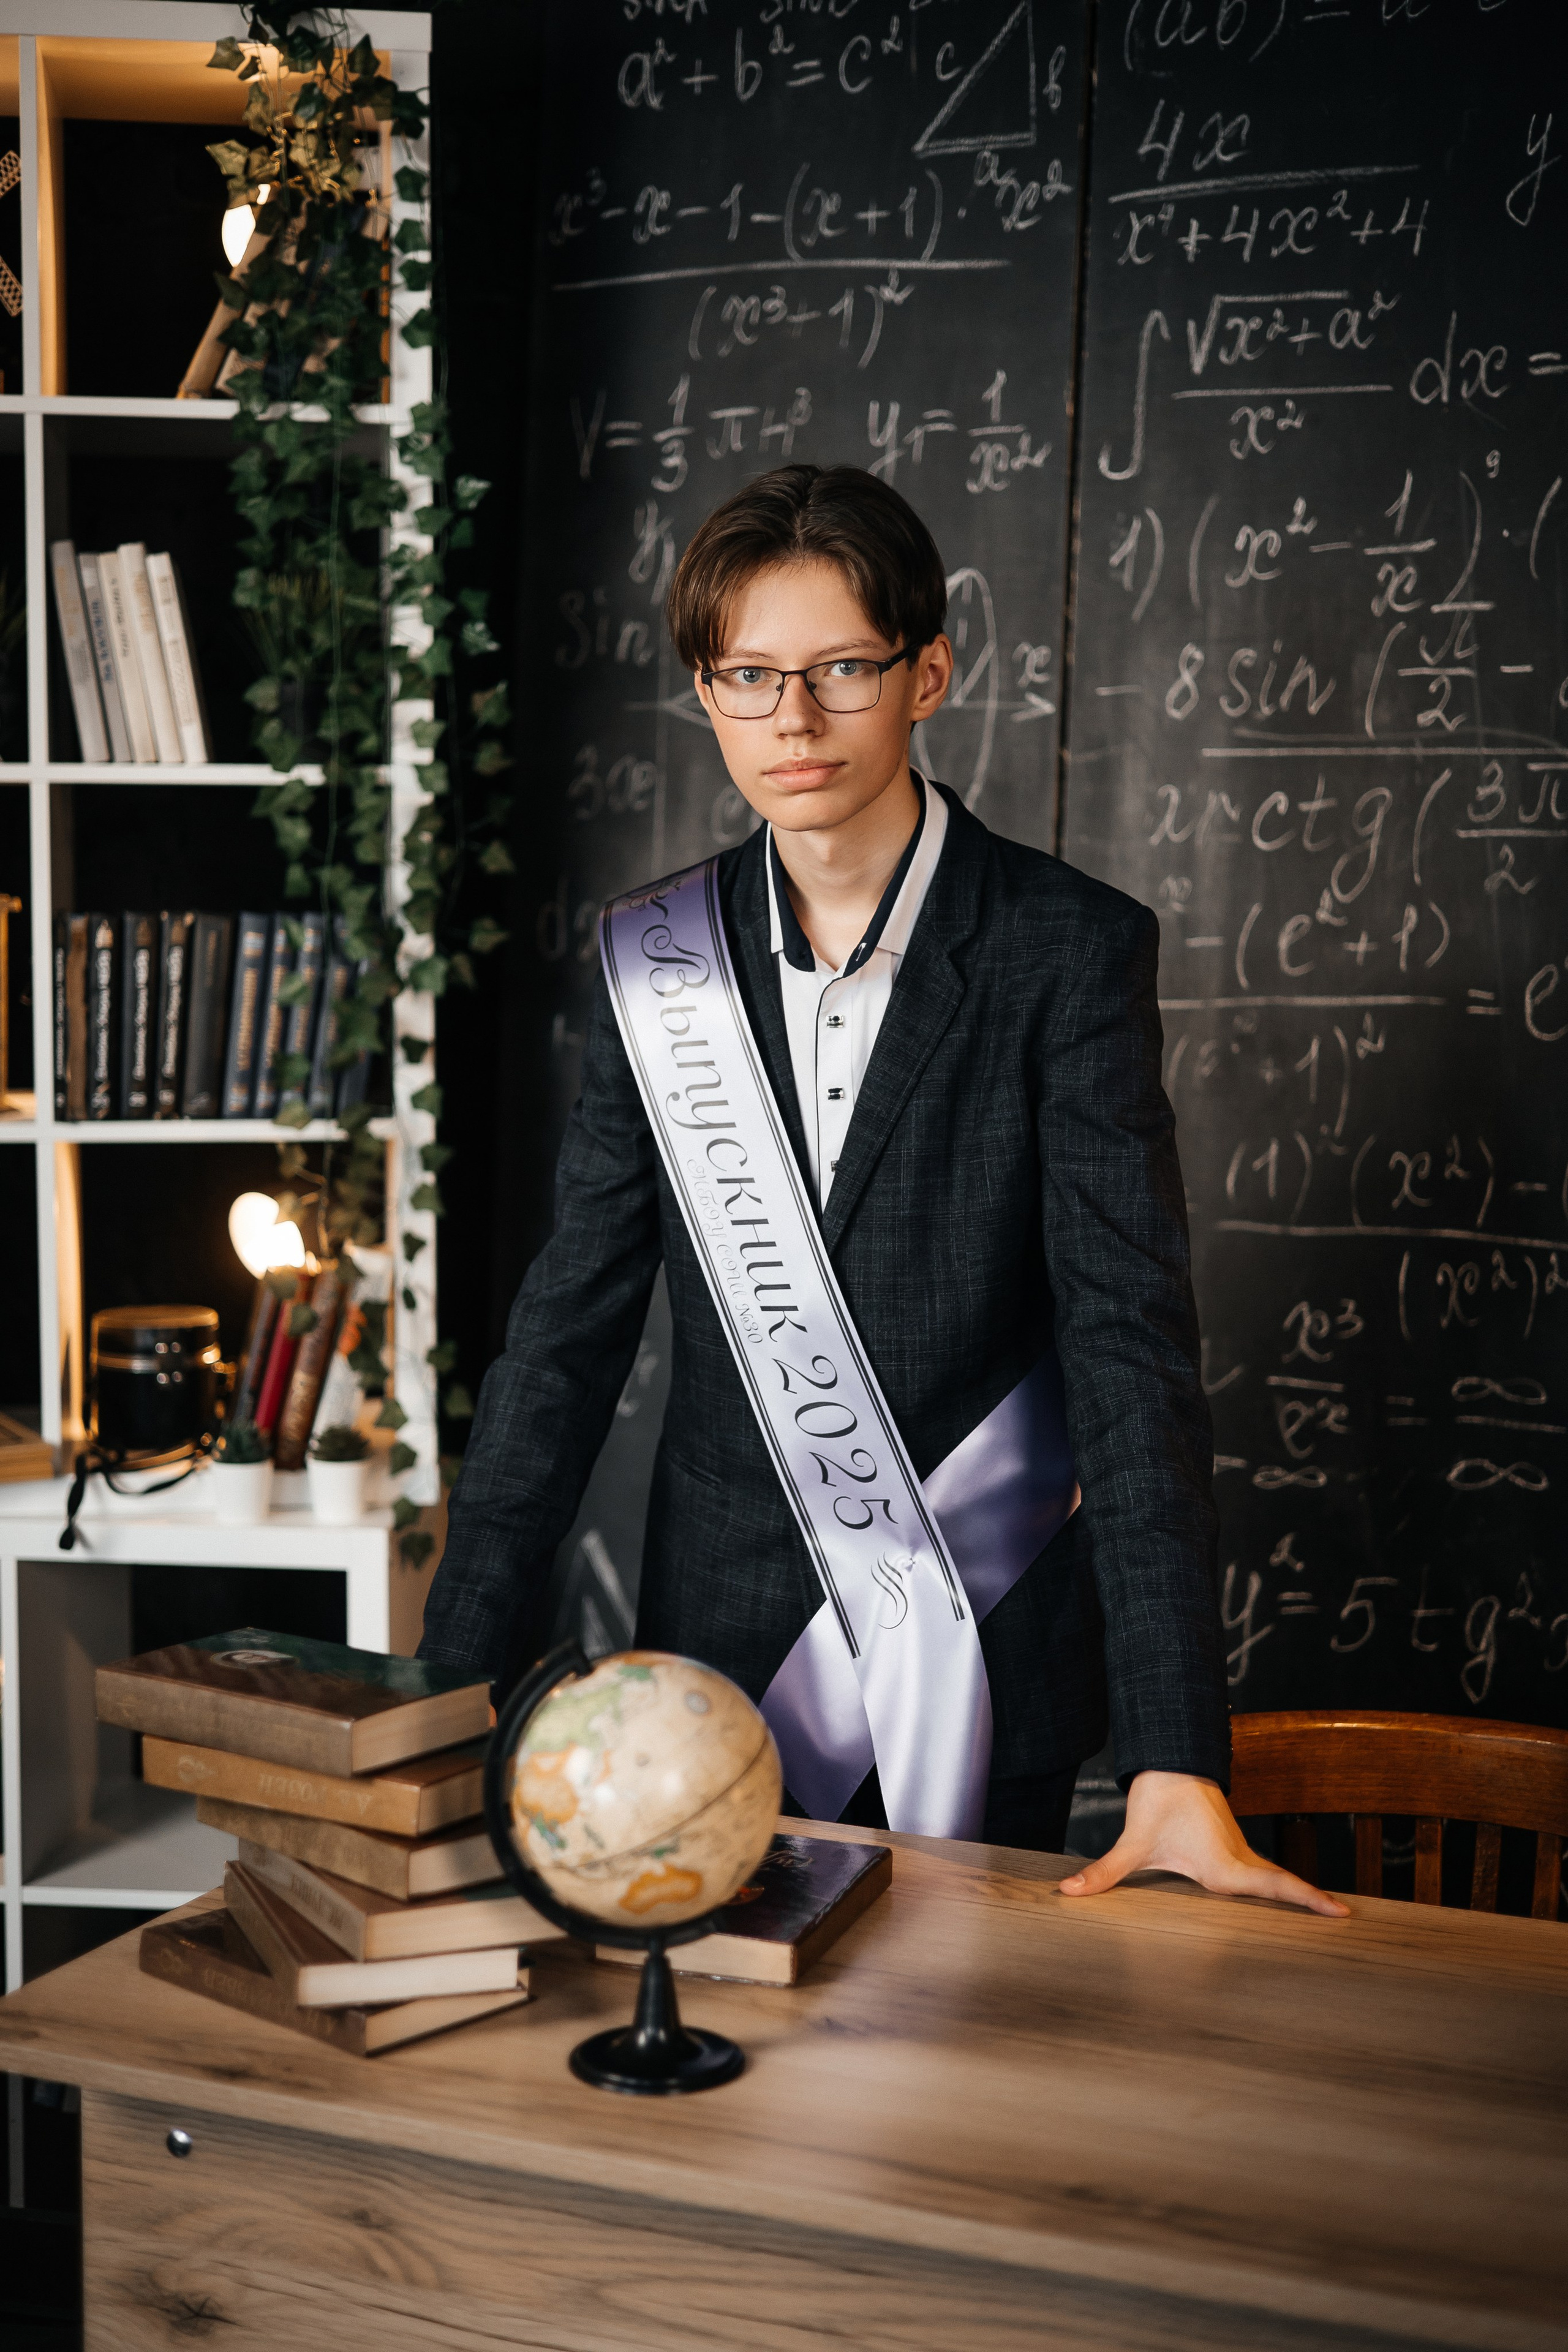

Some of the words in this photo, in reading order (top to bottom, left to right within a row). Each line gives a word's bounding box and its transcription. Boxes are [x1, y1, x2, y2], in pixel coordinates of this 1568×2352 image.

[640, 923, 809, 1343] Выпускник
[771, 1354, 900, 1531] 2025
[685, 1157, 728, 1240] МБОУ
[715, 1243, 748, 1299] СОШ
[734, 1302, 764, 1344] №30
